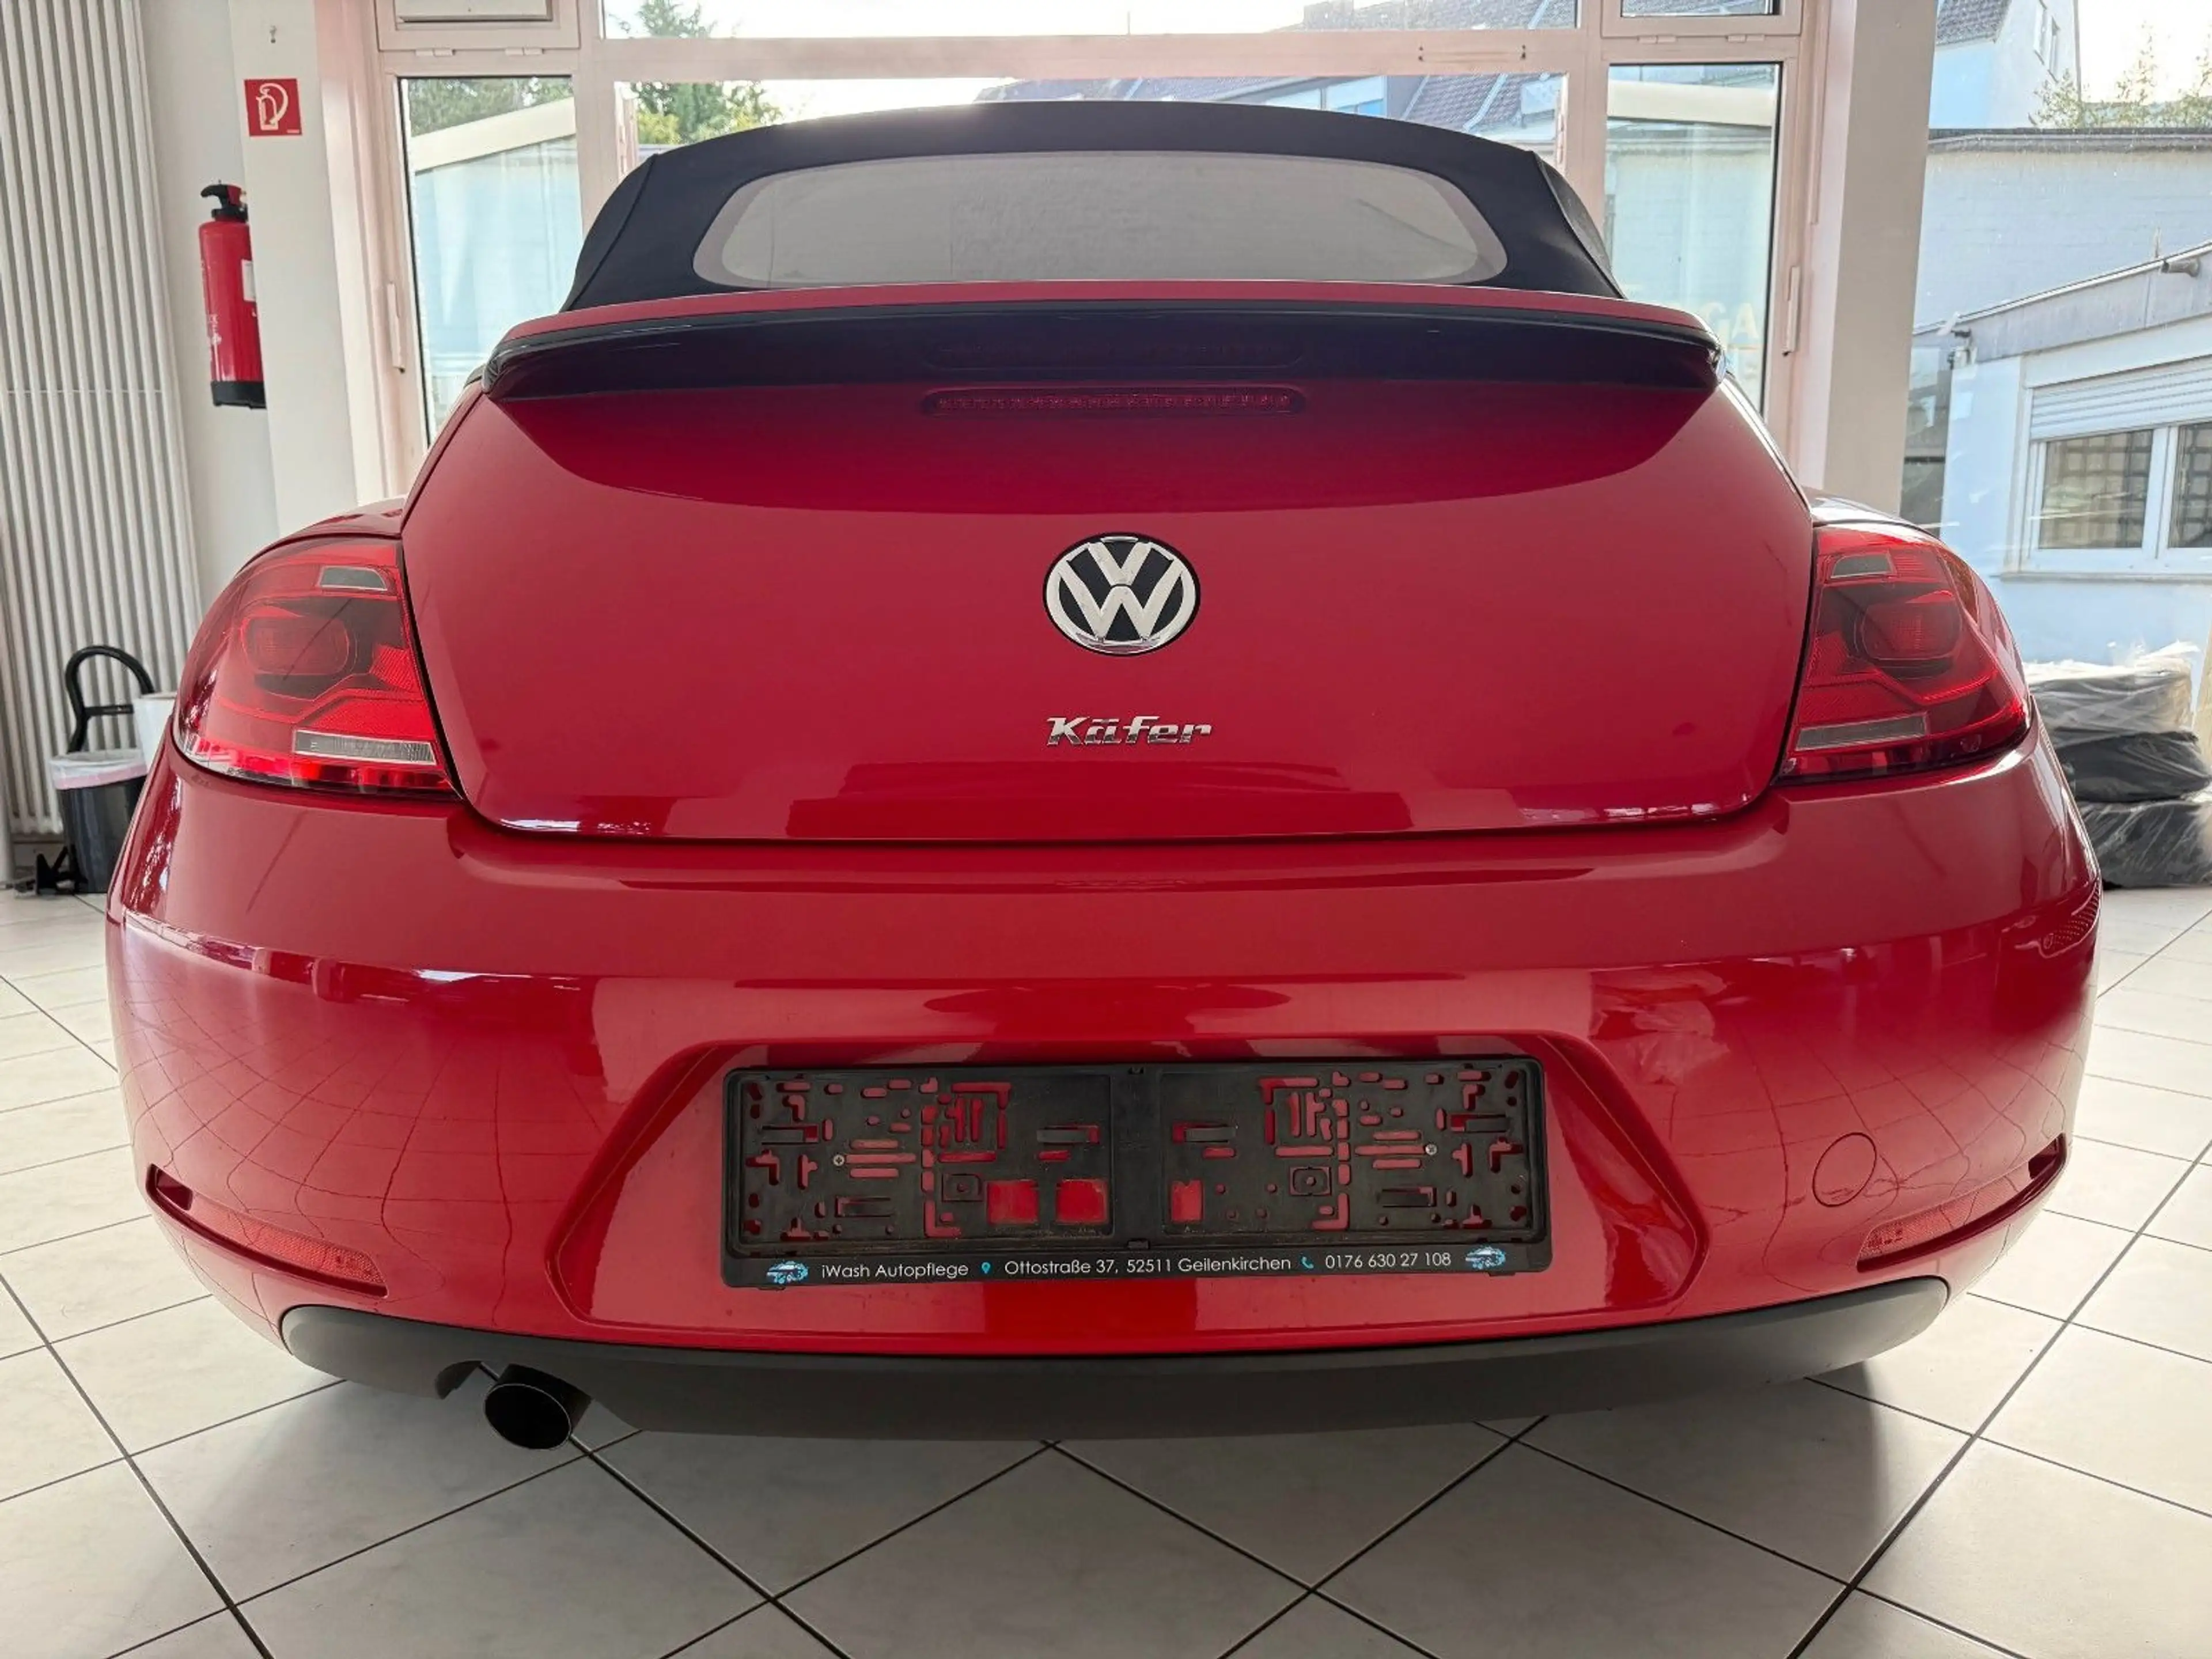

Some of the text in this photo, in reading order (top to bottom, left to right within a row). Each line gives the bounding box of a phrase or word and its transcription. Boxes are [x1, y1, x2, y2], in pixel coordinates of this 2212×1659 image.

[1046, 715, 1212, 745] Käfer
[1005, 1256, 1291, 1274] Ottostraße 37, 52511 Geilenkirchen
[1325, 1252, 1452, 1269] 0176 630 27 108
[821, 1262, 968, 1279] iWash Autopflege
